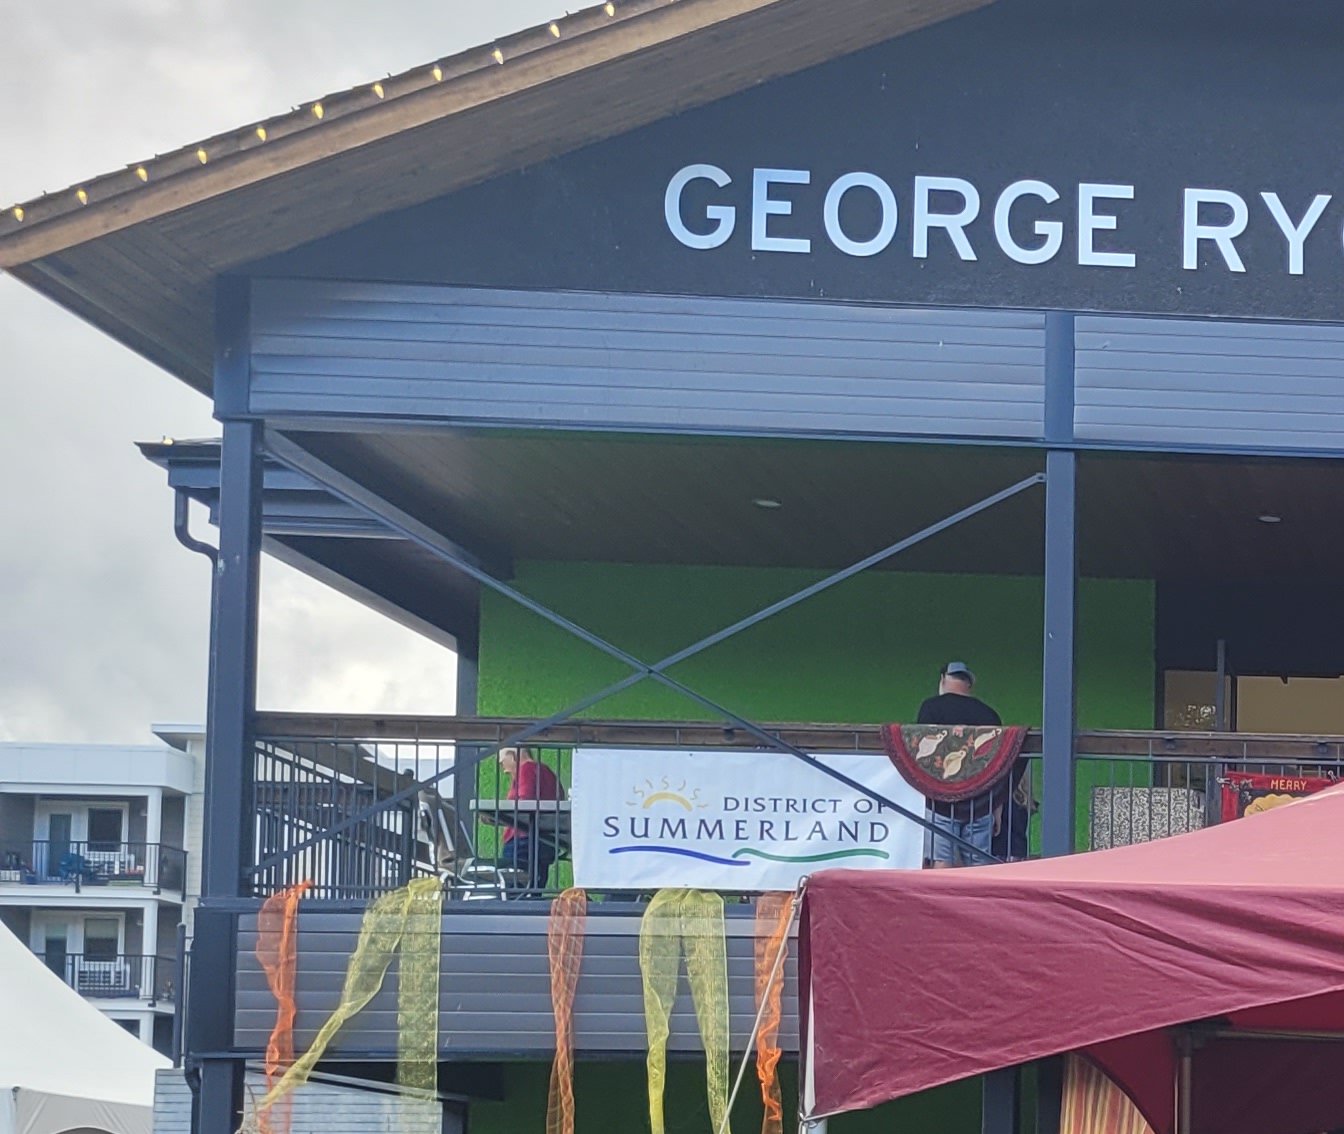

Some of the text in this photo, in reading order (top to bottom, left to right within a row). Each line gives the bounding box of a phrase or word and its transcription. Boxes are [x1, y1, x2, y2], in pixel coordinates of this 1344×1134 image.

[664, 163, 1136, 267] GEORGE
[1270, 779, 1307, 791] MERRY
[723, 796, 842, 814] DISTRICT
[603, 816, 890, 843] SUMMERLAND
